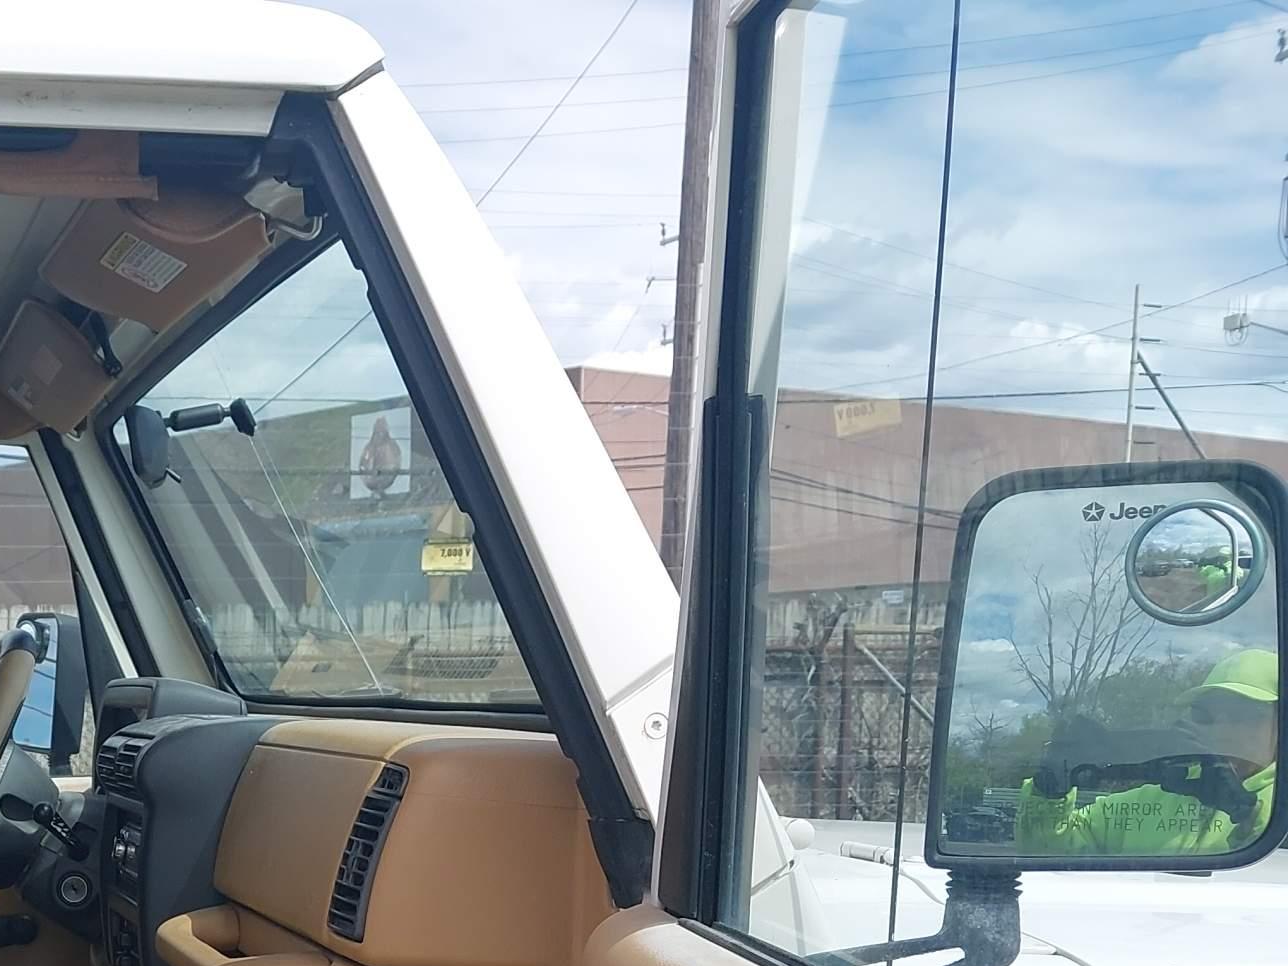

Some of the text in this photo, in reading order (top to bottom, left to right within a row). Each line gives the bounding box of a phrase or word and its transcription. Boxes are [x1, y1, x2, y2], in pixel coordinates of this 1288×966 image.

[1103, 802, 1162, 816] MIRROR
[1104, 817, 1144, 831] THEY
[1156, 818, 1223, 833] APPEAR
